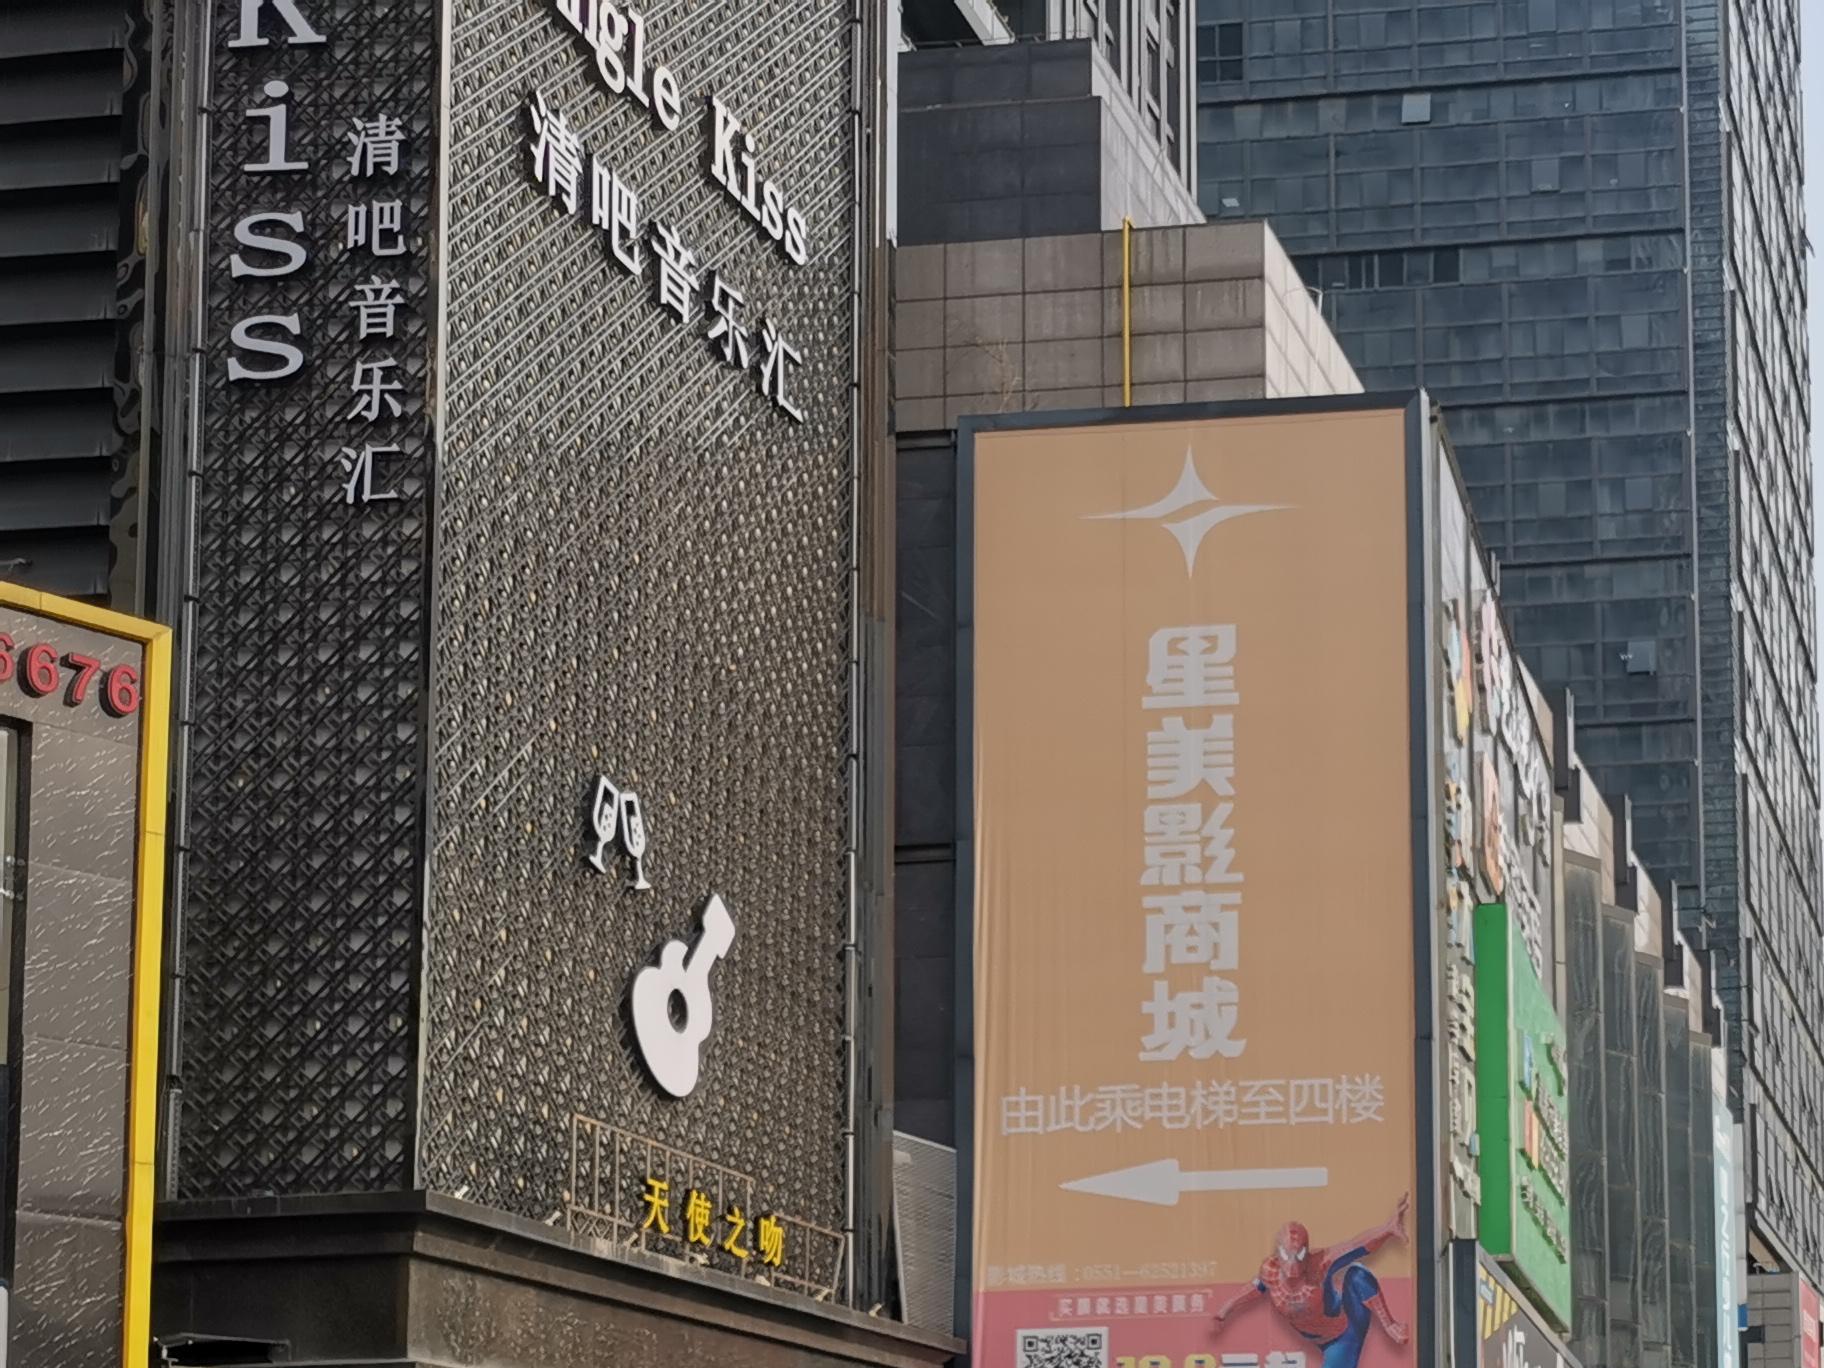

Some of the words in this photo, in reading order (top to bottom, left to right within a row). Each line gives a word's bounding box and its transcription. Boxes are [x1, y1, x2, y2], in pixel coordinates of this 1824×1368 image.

[530, 89, 804, 424] 清吧音乐汇
[556, 0, 681, 131] ngle
[710, 95, 807, 266] Kiss
[340, 113, 407, 504] 清吧音乐汇
[1138, 623, 1246, 1061] 星美影商城
[643, 1178, 784, 1266] 天使之吻
[999, 1074, 1385, 1135] 由此乘电梯至四楼
